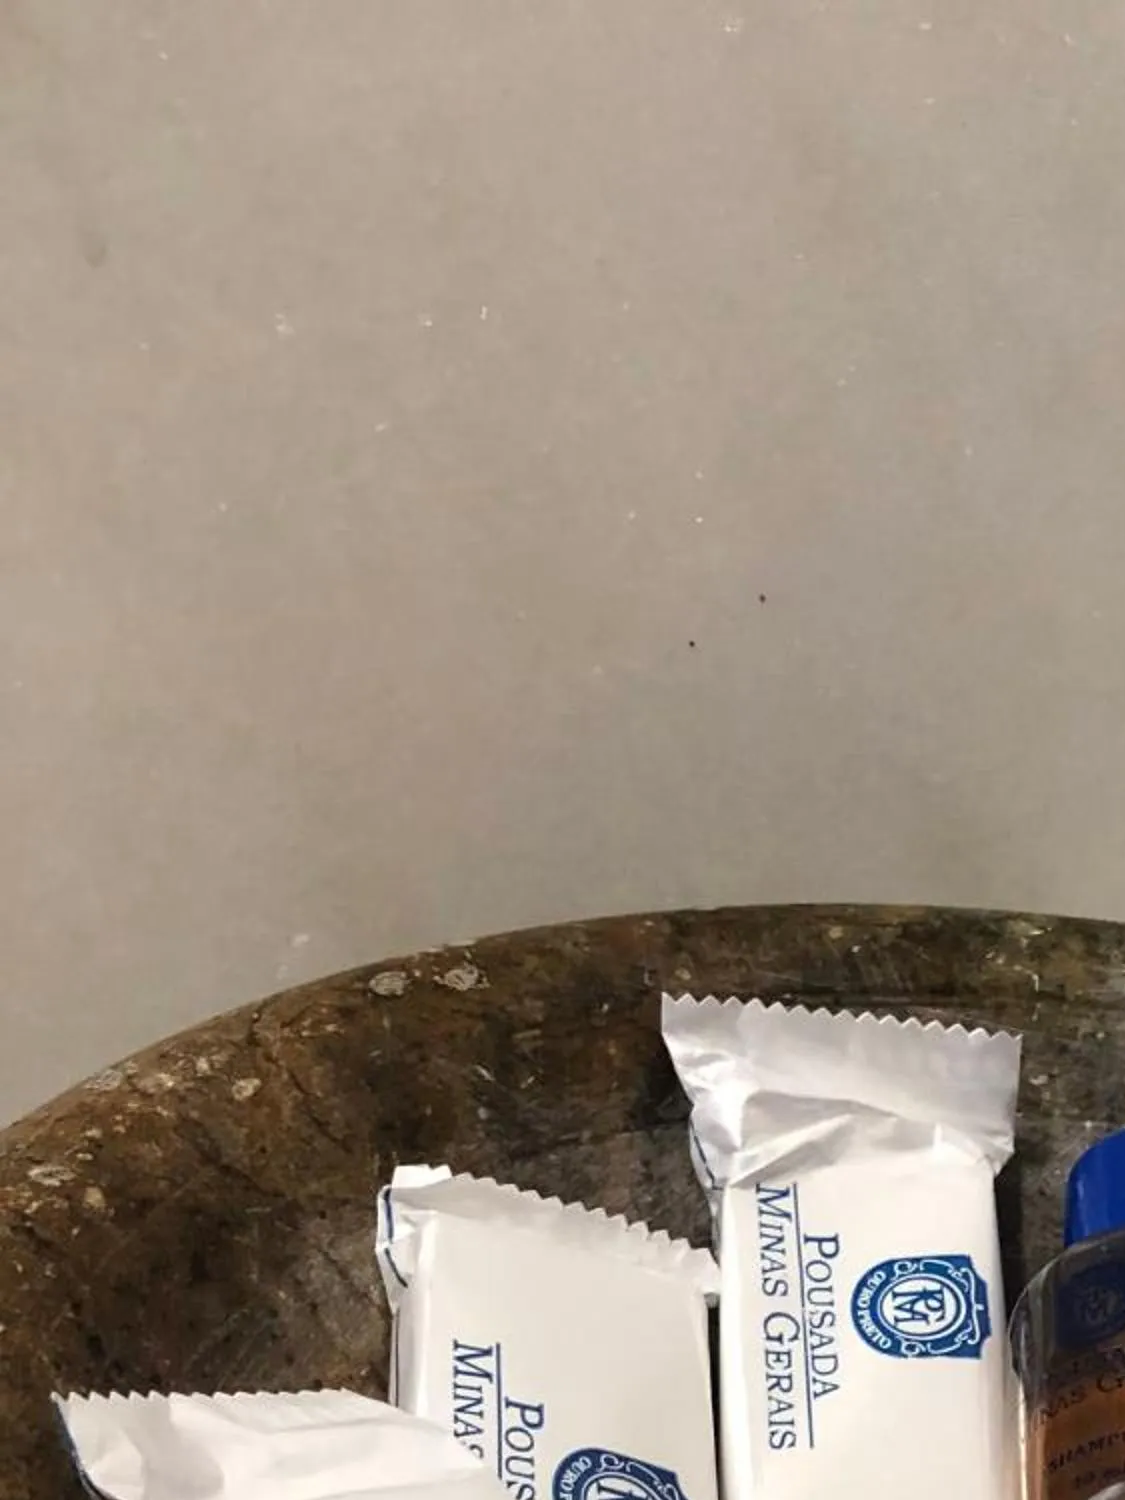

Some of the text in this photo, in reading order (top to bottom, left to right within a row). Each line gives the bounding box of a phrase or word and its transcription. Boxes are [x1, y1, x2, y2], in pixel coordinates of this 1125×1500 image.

[756, 1181, 800, 1450] MINAS GERAIS
[803, 1233, 840, 1400] POUSADA
